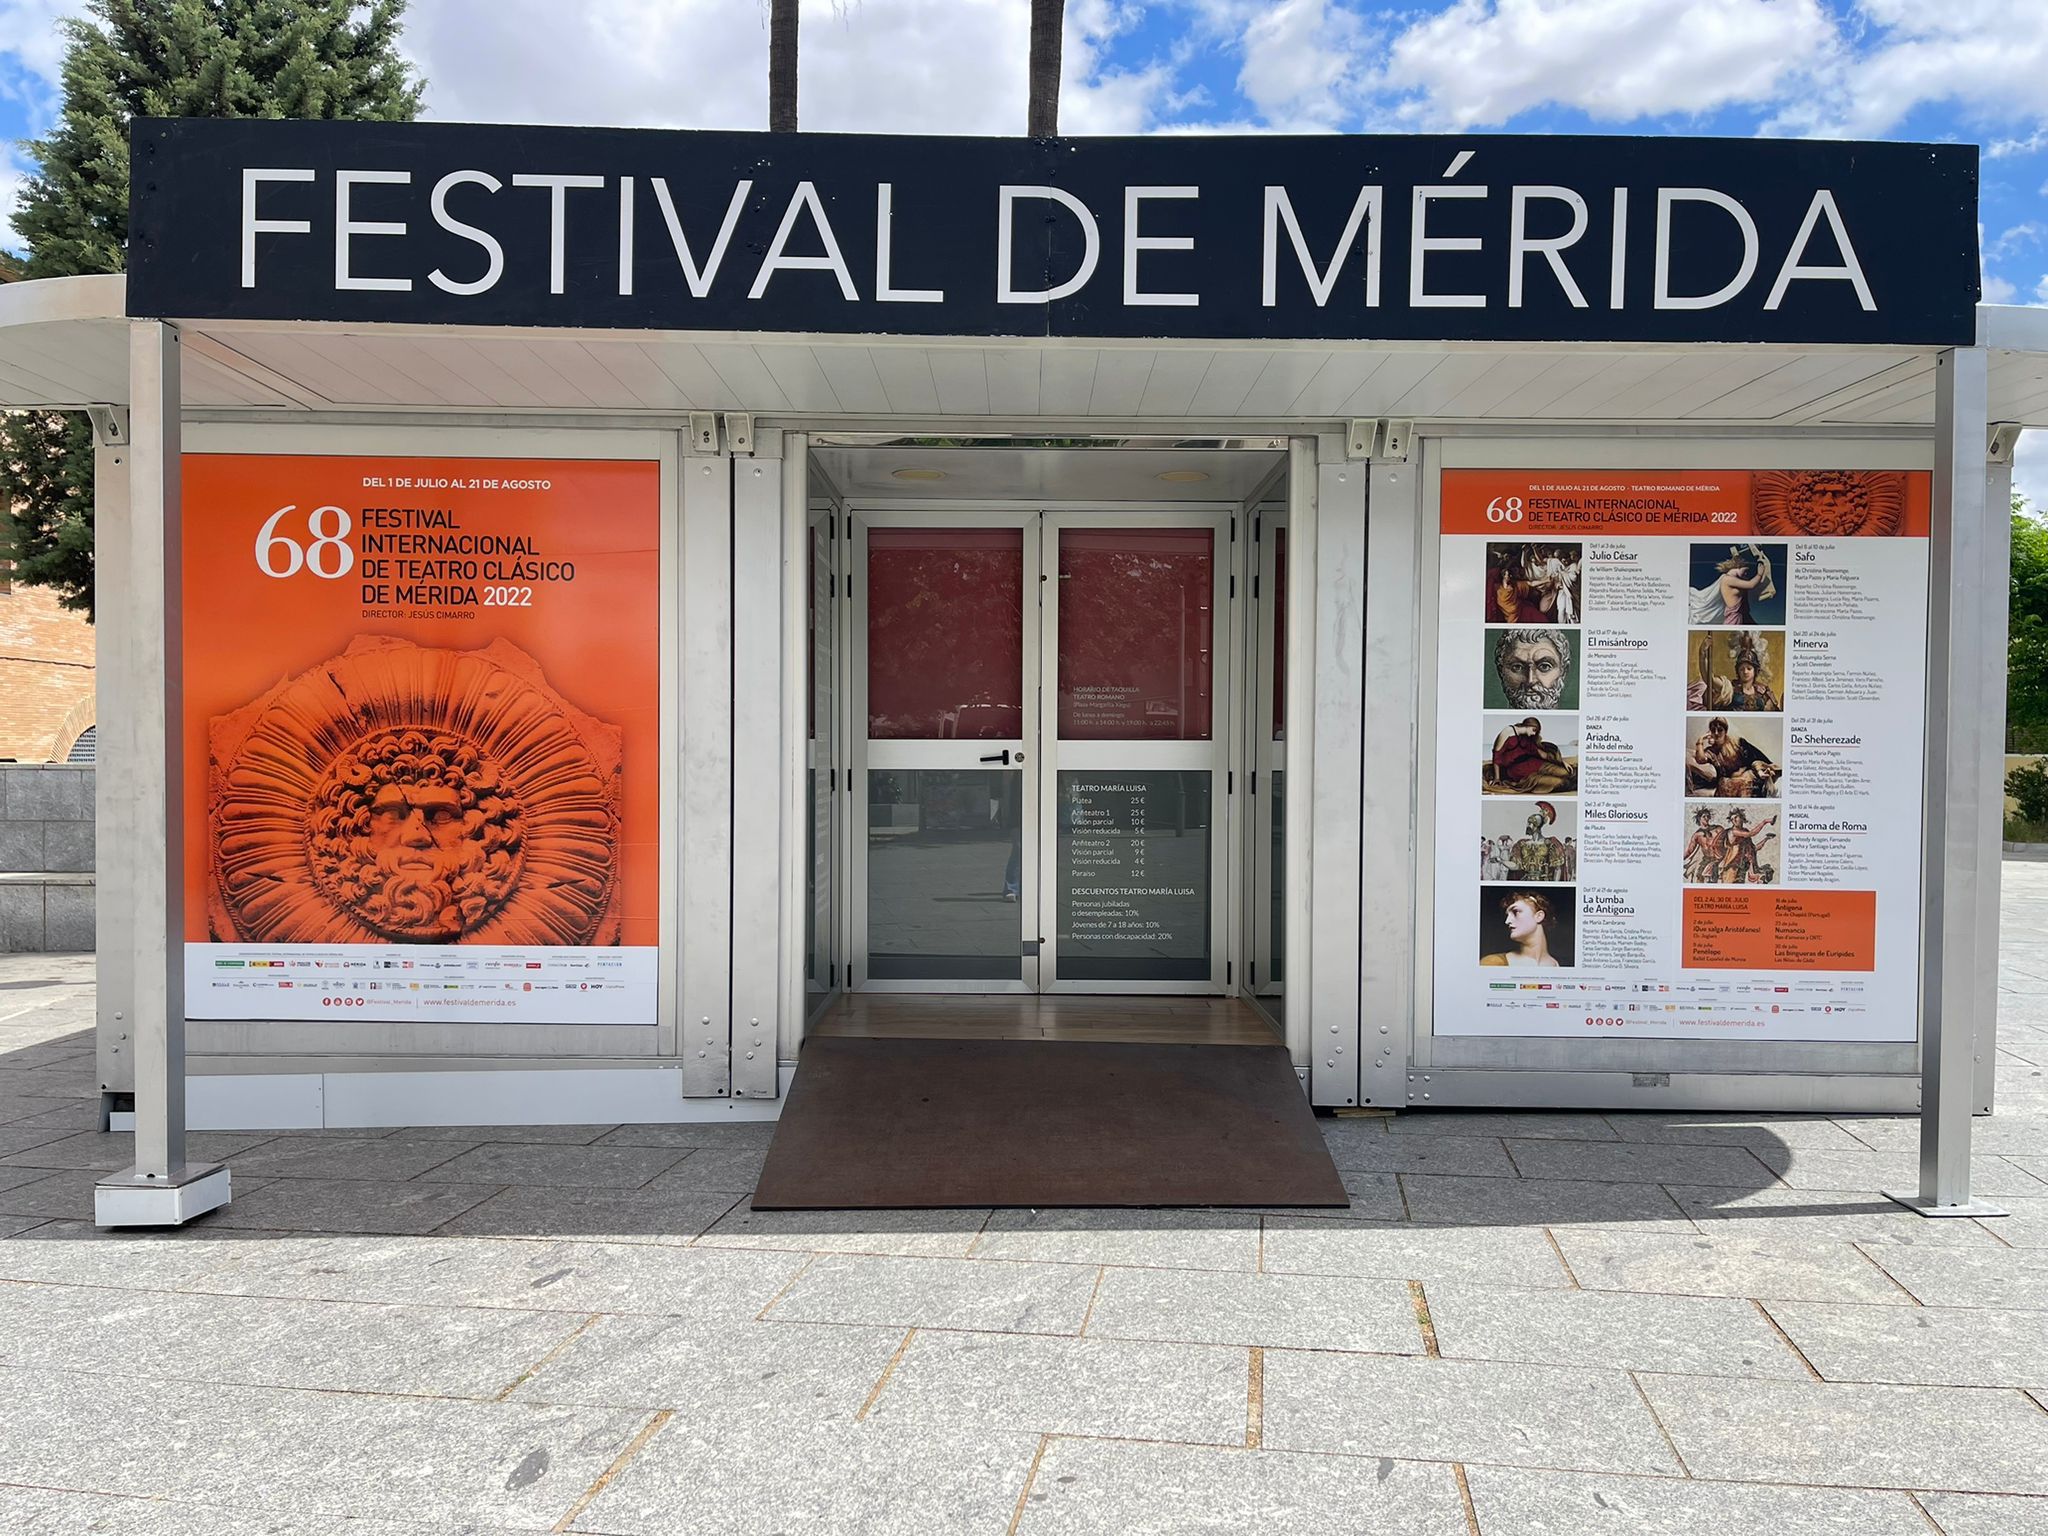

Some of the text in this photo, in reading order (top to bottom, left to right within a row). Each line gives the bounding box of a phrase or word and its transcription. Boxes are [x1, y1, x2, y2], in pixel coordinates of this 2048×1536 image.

[241, 150, 1878, 312] FESTIVAL DE MÉRIDA
[362, 478, 551, 490] DEL 1 DE JULIO AL 21 DE AGOSTO
[1529, 499, 1678, 509] FESTIVAL INTERNACIONAL
[1486, 497, 1523, 523] 68
[362, 508, 460, 529] FESTIVAL
[1529, 509, 1737, 523] DE TEATRO CLÁSICO DE MÉRIDA 2022
[255, 505, 354, 579] 68
[362, 534, 540, 555] INTERNACIONAL
[1590, 551, 1638, 560] Julio César
[1795, 552, 1815, 561] Safo
[362, 556, 575, 581] DE TEATRO CLÁSICO
[362, 580, 532, 607] DE MÉRIDA 2022
[362, 609, 475, 619] DIRECTOR: JESÚS CIMARRO
[1588, 637, 1648, 648] El misántropo
[1793, 639, 1829, 648] Minerva
[1586, 732, 1621, 742] Ariadna,
[1791, 734, 1861, 744] De Sheherezade
[1585, 810, 1648, 819] Miles Gloriosus
[1789, 821, 1867, 831] El aroma de Roma
[1149, 887, 1173, 895] MARÍA
[1583, 895, 1624, 904] La tumba
[1583, 905, 1634, 916] de Antígona
[1679, 1019, 1765, 1027] www.festivaldemerida.es
